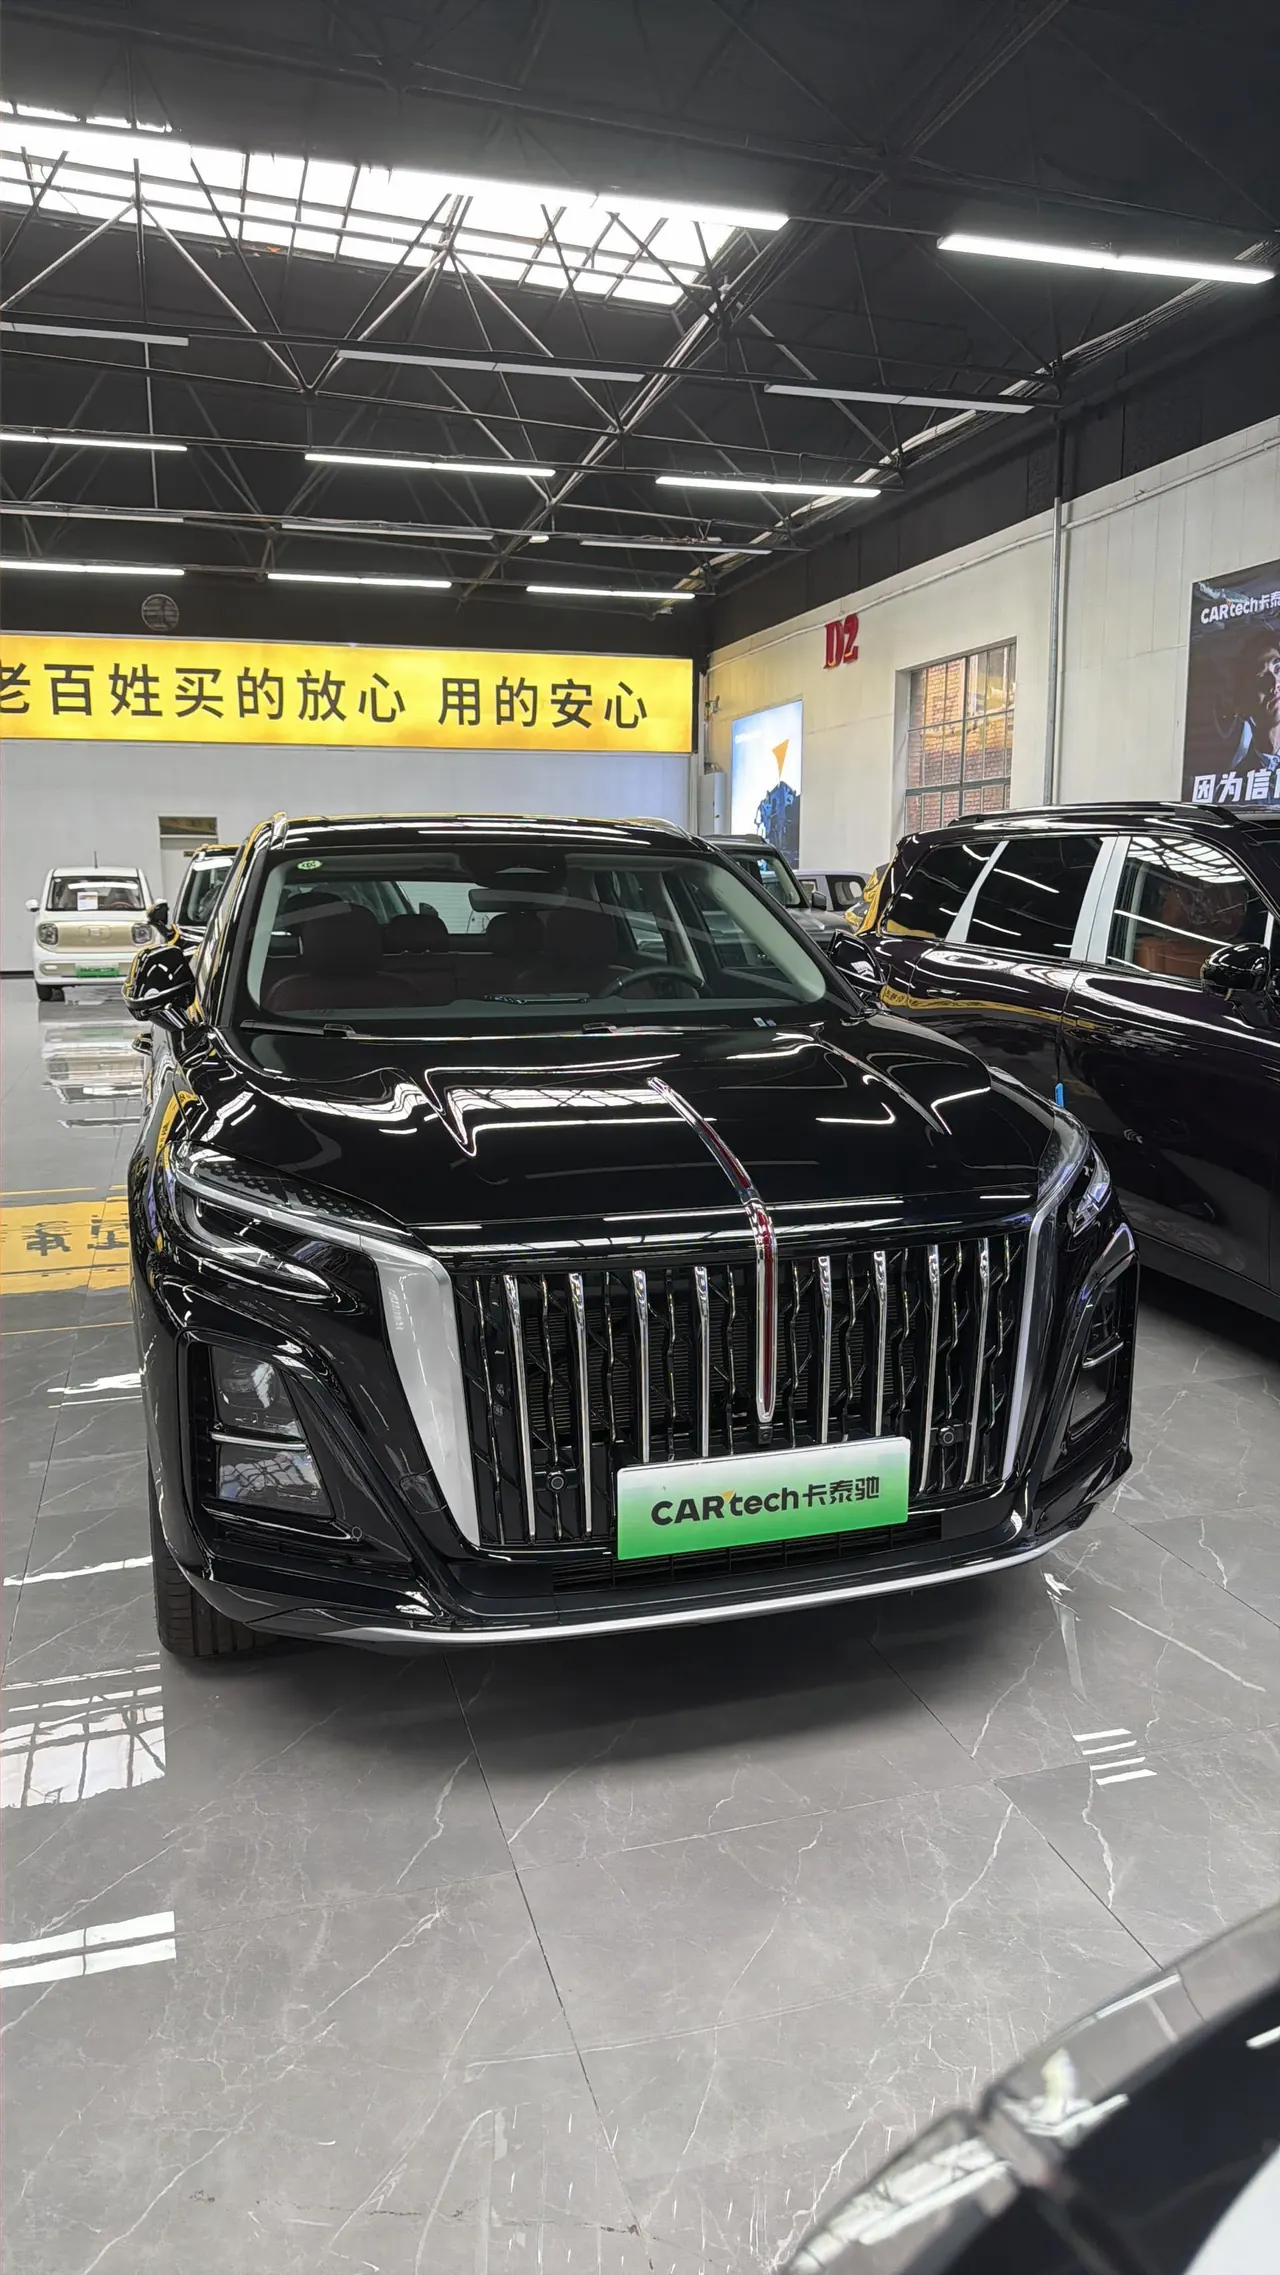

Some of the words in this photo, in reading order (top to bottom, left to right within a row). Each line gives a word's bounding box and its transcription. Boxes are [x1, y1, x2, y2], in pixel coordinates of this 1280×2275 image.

[823, 613, 859, 670] D2
[0, 659, 406, 722] 老百姓买的放心
[438, 676, 648, 729] 用的安心
[1192, 768, 1280, 804] 因为信
[651, 1475, 880, 1526] CARtech卡泰驰
